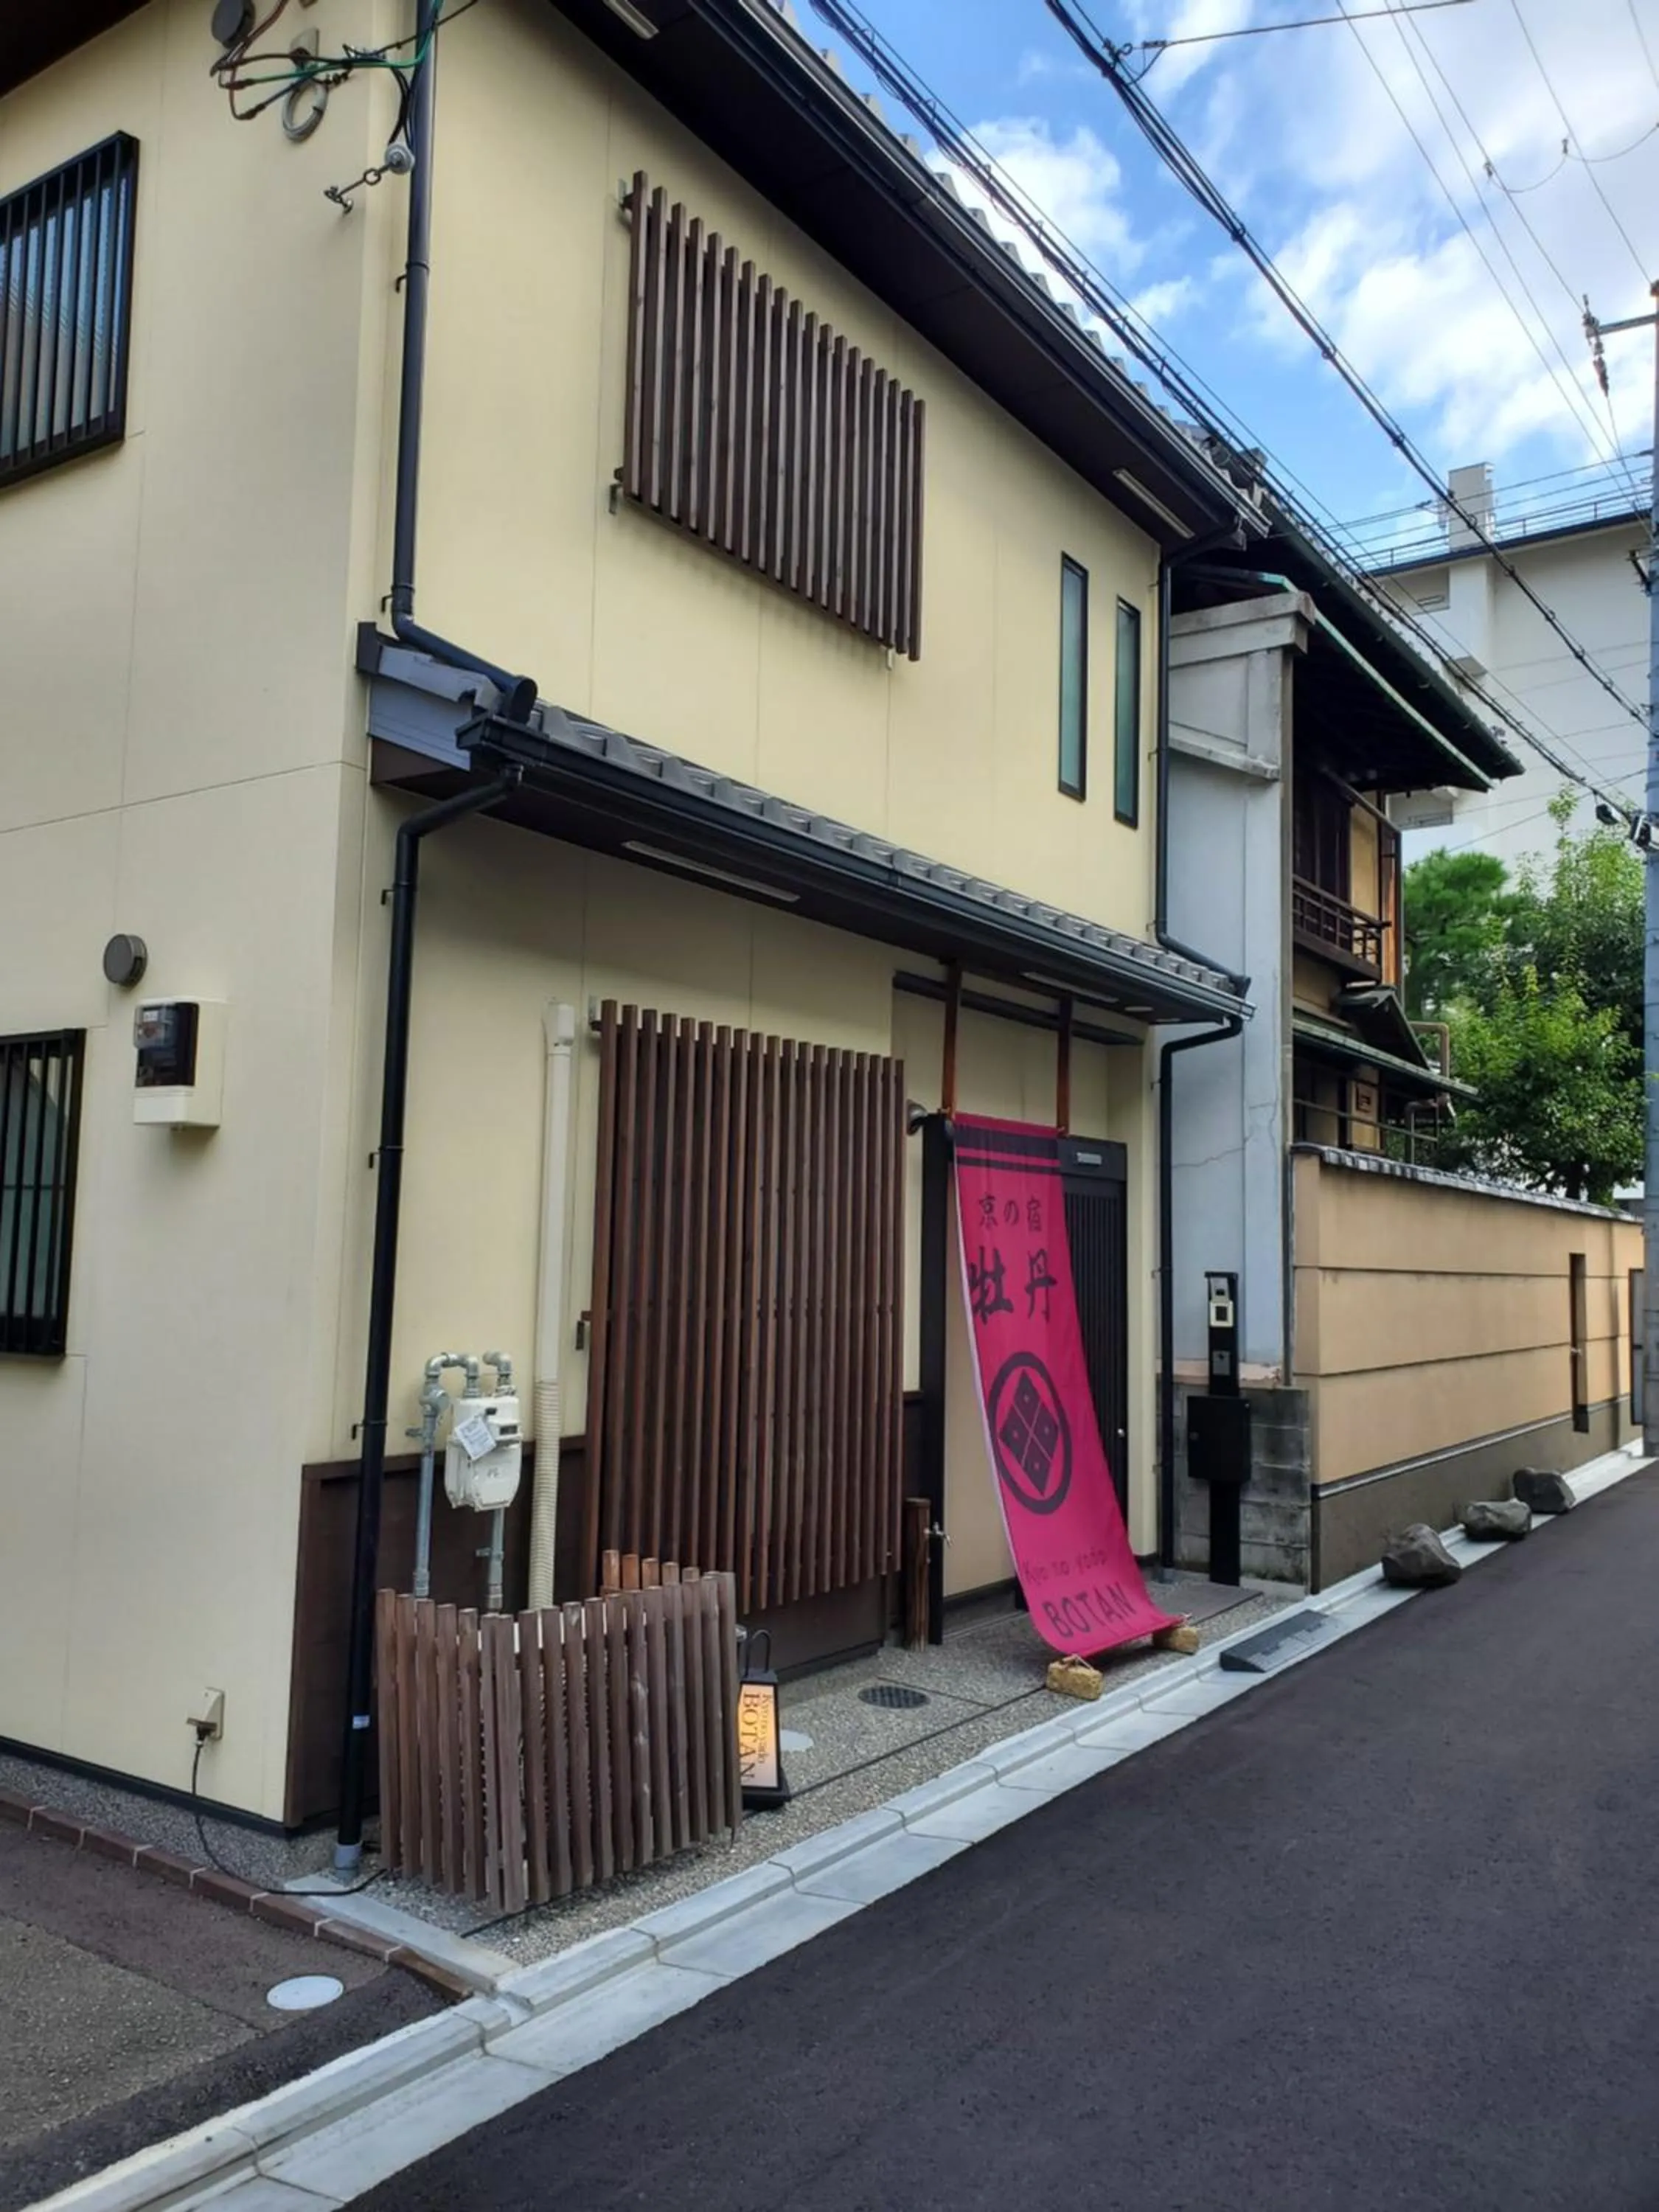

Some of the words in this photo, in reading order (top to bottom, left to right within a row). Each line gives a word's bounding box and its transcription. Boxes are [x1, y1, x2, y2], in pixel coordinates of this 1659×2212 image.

[978, 1192, 1042, 1232] 京の宿
[967, 1245, 1057, 1325] 牡丹
[1041, 1581, 1136, 1638] BOTAN
[740, 1692, 759, 1782] BOTAN
